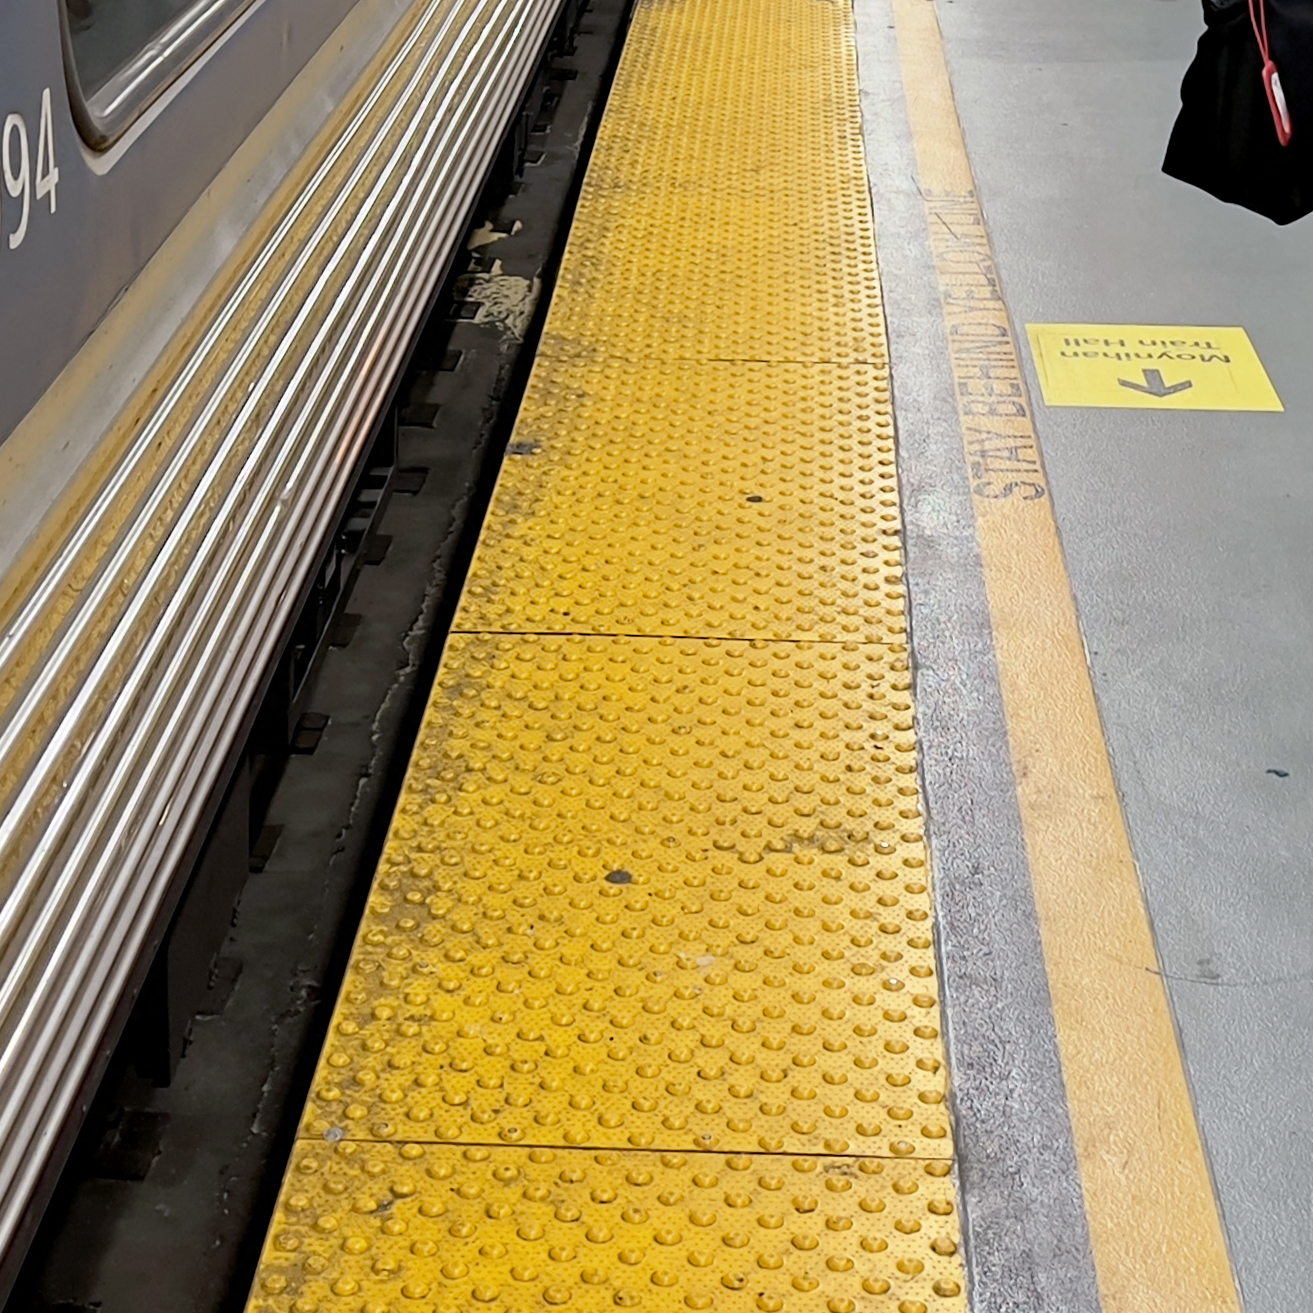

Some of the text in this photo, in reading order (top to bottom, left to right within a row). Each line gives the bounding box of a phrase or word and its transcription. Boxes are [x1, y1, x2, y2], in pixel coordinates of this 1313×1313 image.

[1060, 350, 1231, 364] Moynihan
[1063, 338, 1220, 350] Train Hall
[949, 322, 1026, 417] BEHIND
[968, 425, 1047, 500] STAY
